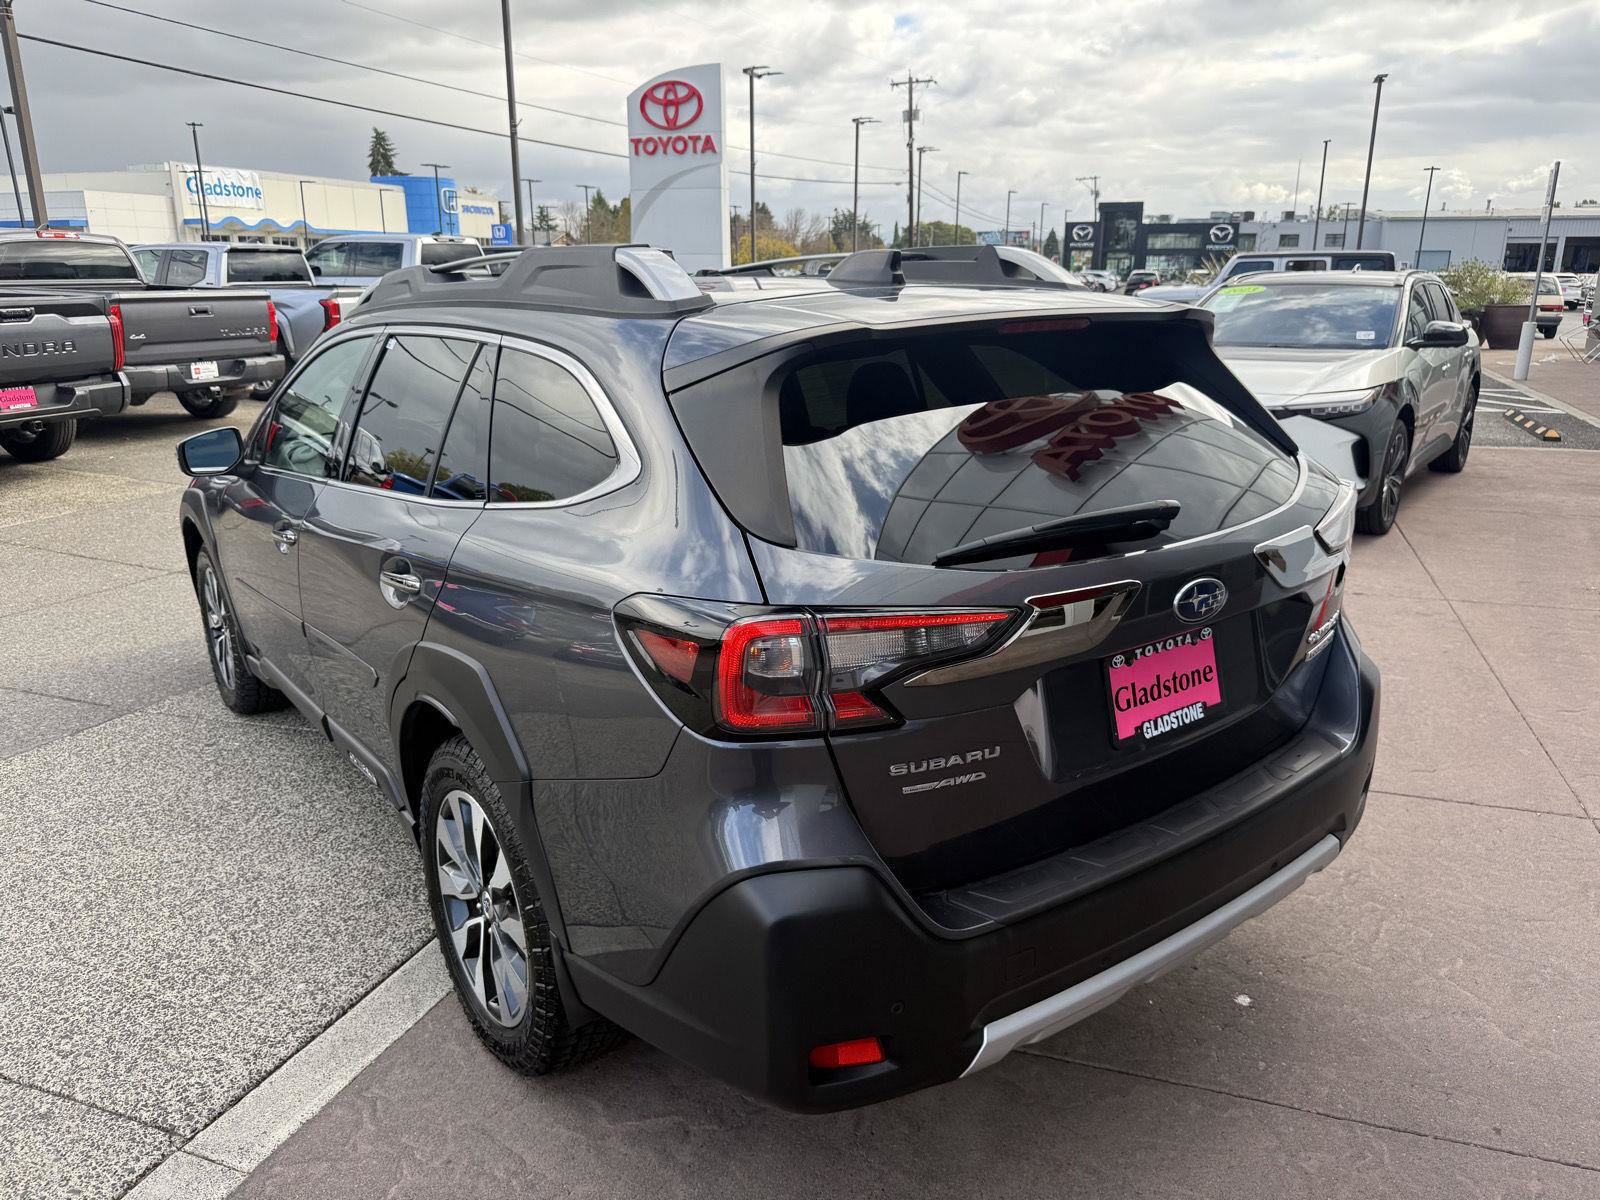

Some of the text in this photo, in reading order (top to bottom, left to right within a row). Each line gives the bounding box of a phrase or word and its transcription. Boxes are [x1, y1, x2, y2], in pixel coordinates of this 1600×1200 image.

[630, 135, 717, 156] TOYOTA
[186, 175, 262, 199] Gadstone
[1135, 633, 1192, 660] TOYOTA
[1115, 664, 1214, 712] Gladstone
[1143, 702, 1205, 739] GLADSTONE
[889, 745, 1001, 777] SUBARU
[935, 771, 987, 789] AWD
